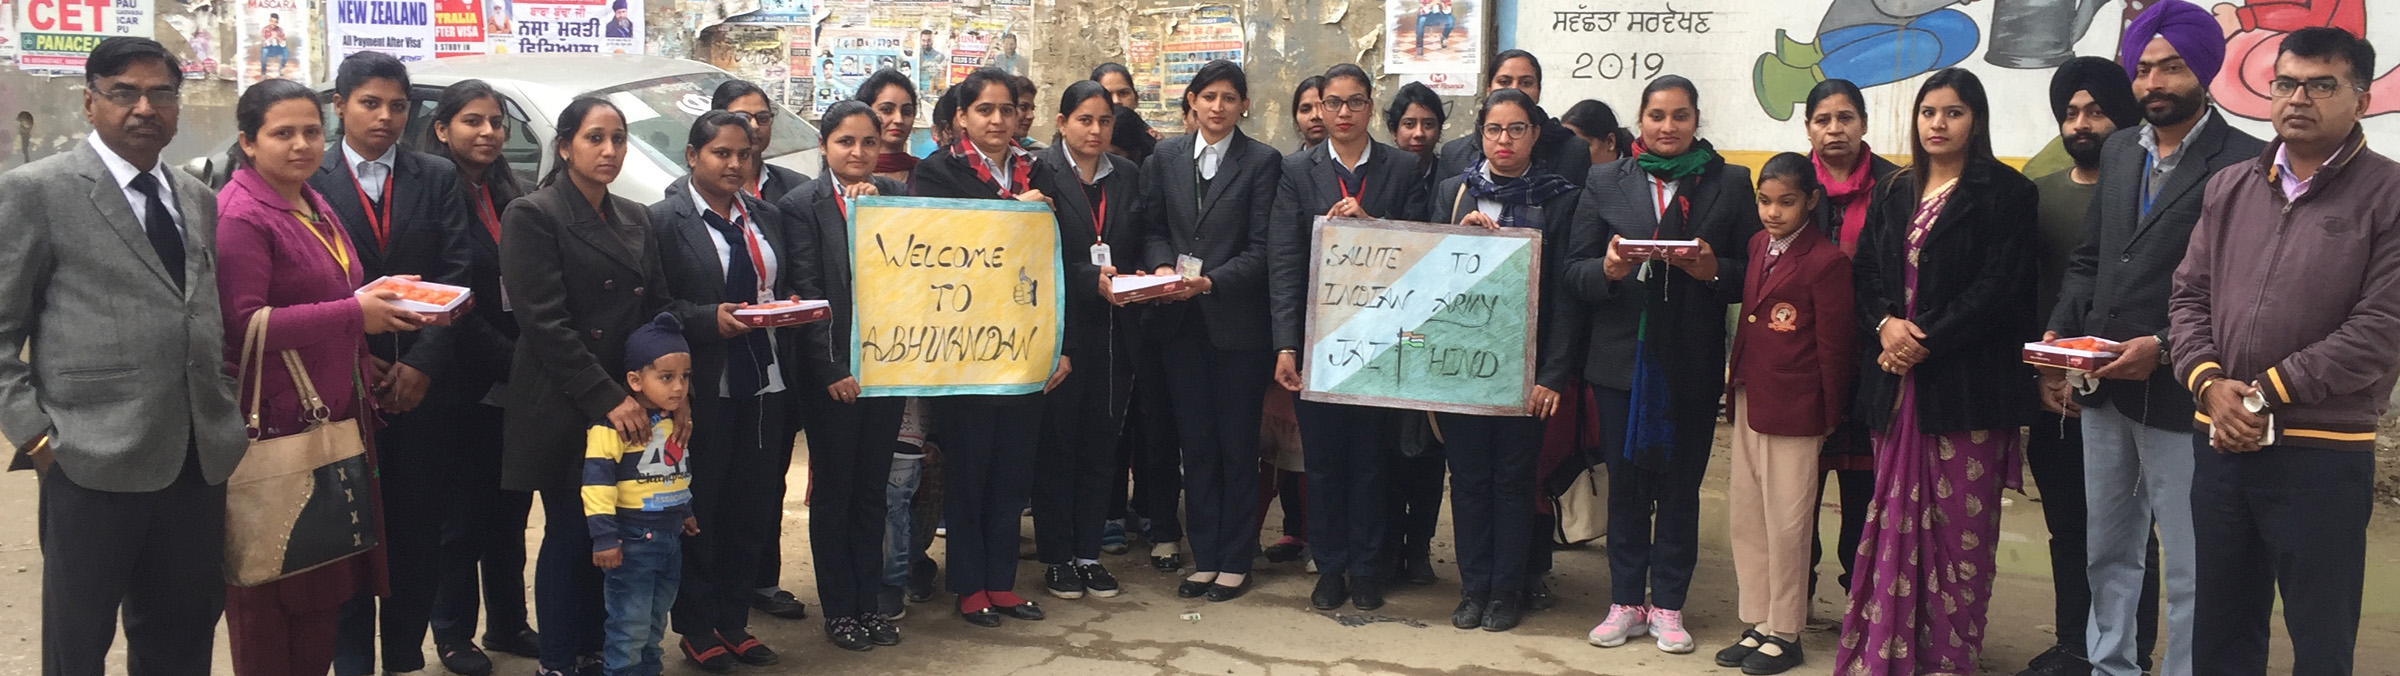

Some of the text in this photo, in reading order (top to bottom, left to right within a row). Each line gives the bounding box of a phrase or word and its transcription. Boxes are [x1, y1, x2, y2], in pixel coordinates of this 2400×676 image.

[28, 0, 111, 32] CET
[116, 0, 137, 8] PAU
[338, 1, 427, 26] NEW ZEALAND
[435, 12, 478, 24] TRALIA
[116, 16, 139, 24] ICAR
[456, 26, 479, 37] VISA
[343, 35, 352, 46] All
[354, 35, 385, 48] Payment
[387, 36, 405, 47] After
[1571, 52, 1664, 80] 2019
[875, 233, 1005, 268] WELCOME
[1326, 243, 1481, 274] SALUTE TO
[931, 284, 973, 312] TO
[1321, 282, 1499, 325] INDIAN ARMY
[862, 325, 1038, 363] ABHINANDAN
[1328, 339, 1499, 379] JAI HIND
